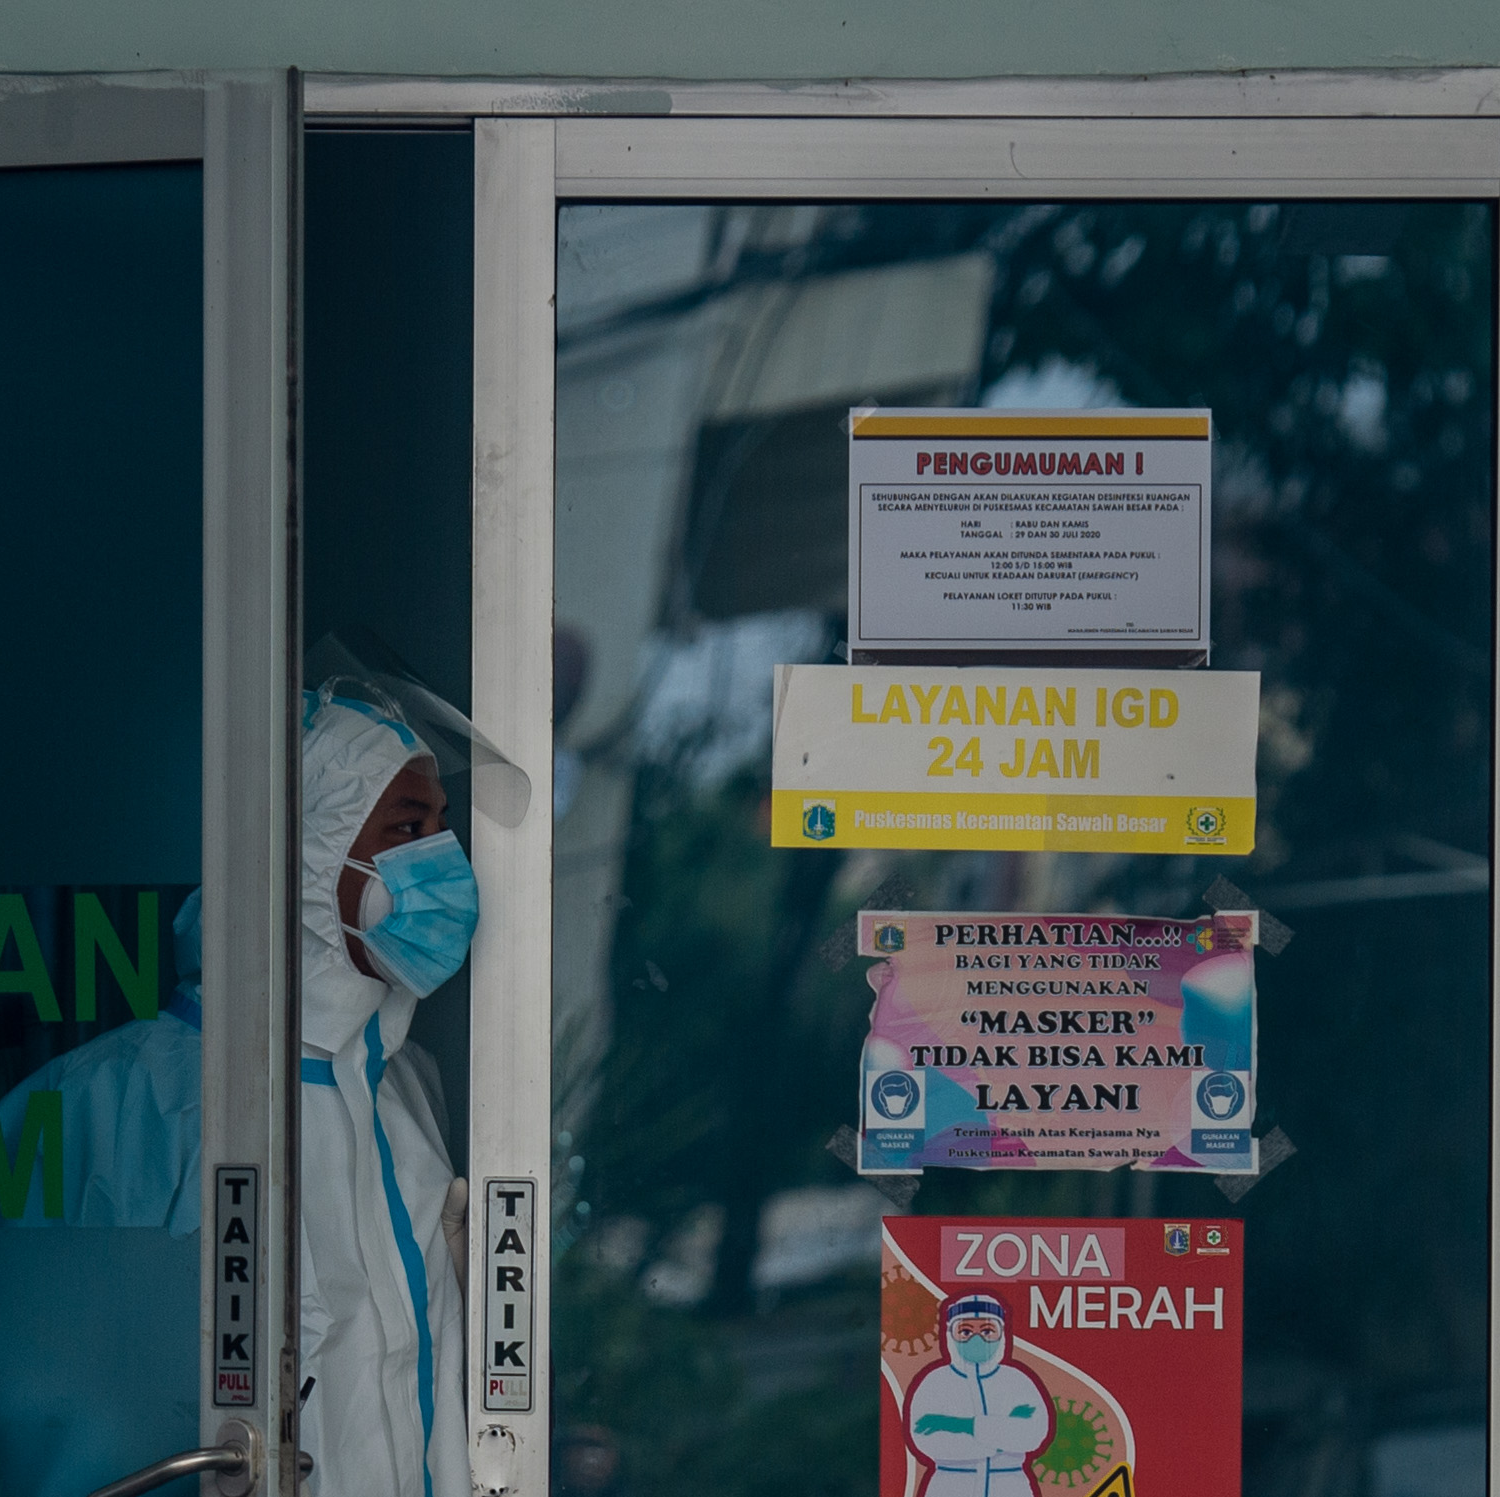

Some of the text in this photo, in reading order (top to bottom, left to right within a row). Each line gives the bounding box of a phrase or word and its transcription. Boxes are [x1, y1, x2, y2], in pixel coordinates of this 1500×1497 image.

[916, 452, 1124, 476] PENGUMUMAN
[872, 493, 1190, 501] SEHUBUNGAN DENGAN AKAN DILAKUKAN KEGIATAN DESINFEKSI RUANGAN
[878, 503, 912, 511] SECARA
[914, 503, 970, 511] MENYELURUH
[973, 503, 981, 511] DI
[984, 503, 1032, 511] PUSKESMAS
[1035, 503, 1090, 511] KECAMATAN
[1092, 503, 1124, 511] SAWAH
[1126, 503, 1152, 511] BESAR
[1154, 503, 1179, 511] PADA
[900, 551, 927, 559] MAKA
[930, 551, 981, 559] PELAYANAN
[983, 551, 1008, 559] AKAN
[1011, 551, 1048, 559] DITUNDA
[1051, 551, 1101, 559] SEMENTARA
[1103, 551, 1127, 559] PADA
[1130, 551, 1156, 559] PUKUL
[1078, 572, 1139, 580] (EMERGENCY)
[943, 592, 994, 600] PELAYANAN
[997, 592, 1022, 600] LOKET
[1025, 592, 1057, 600] DITUTUP
[1060, 592, 1084, 600] PADA
[1086, 592, 1111, 600] PUKUL
[1012, 603, 1052, 611] 11:30 WIB
[851, 683, 1179, 729] LAYANAN IGD
[926, 736, 1101, 779] 24 JAM
[854, 809, 1168, 834] Puskesmas Kecamatan Sawah Besar
[955, 954, 1161, 970] BAGI YANG TIDAK
[966, 981, 1149, 996] MENGGUNAKAN
[909, 1045, 1205, 1068] TIDAK BISA KAMI
[975, 1083, 1140, 1112] LAYANI
[953, 1128, 1160, 1139] Terima Kasih Atas Kerjasama Nya
[948, 1149, 1165, 1158] Puskesmas Kecamatan Sawah Besar
[954, 1232, 1112, 1277] ZONA
[222, 1178, 250, 1361] TARIK
[494, 1191, 526, 1367] TARIK
[1029, 1287, 1225, 1330] MERAH
[218, 1373, 250, 1390] PULL
